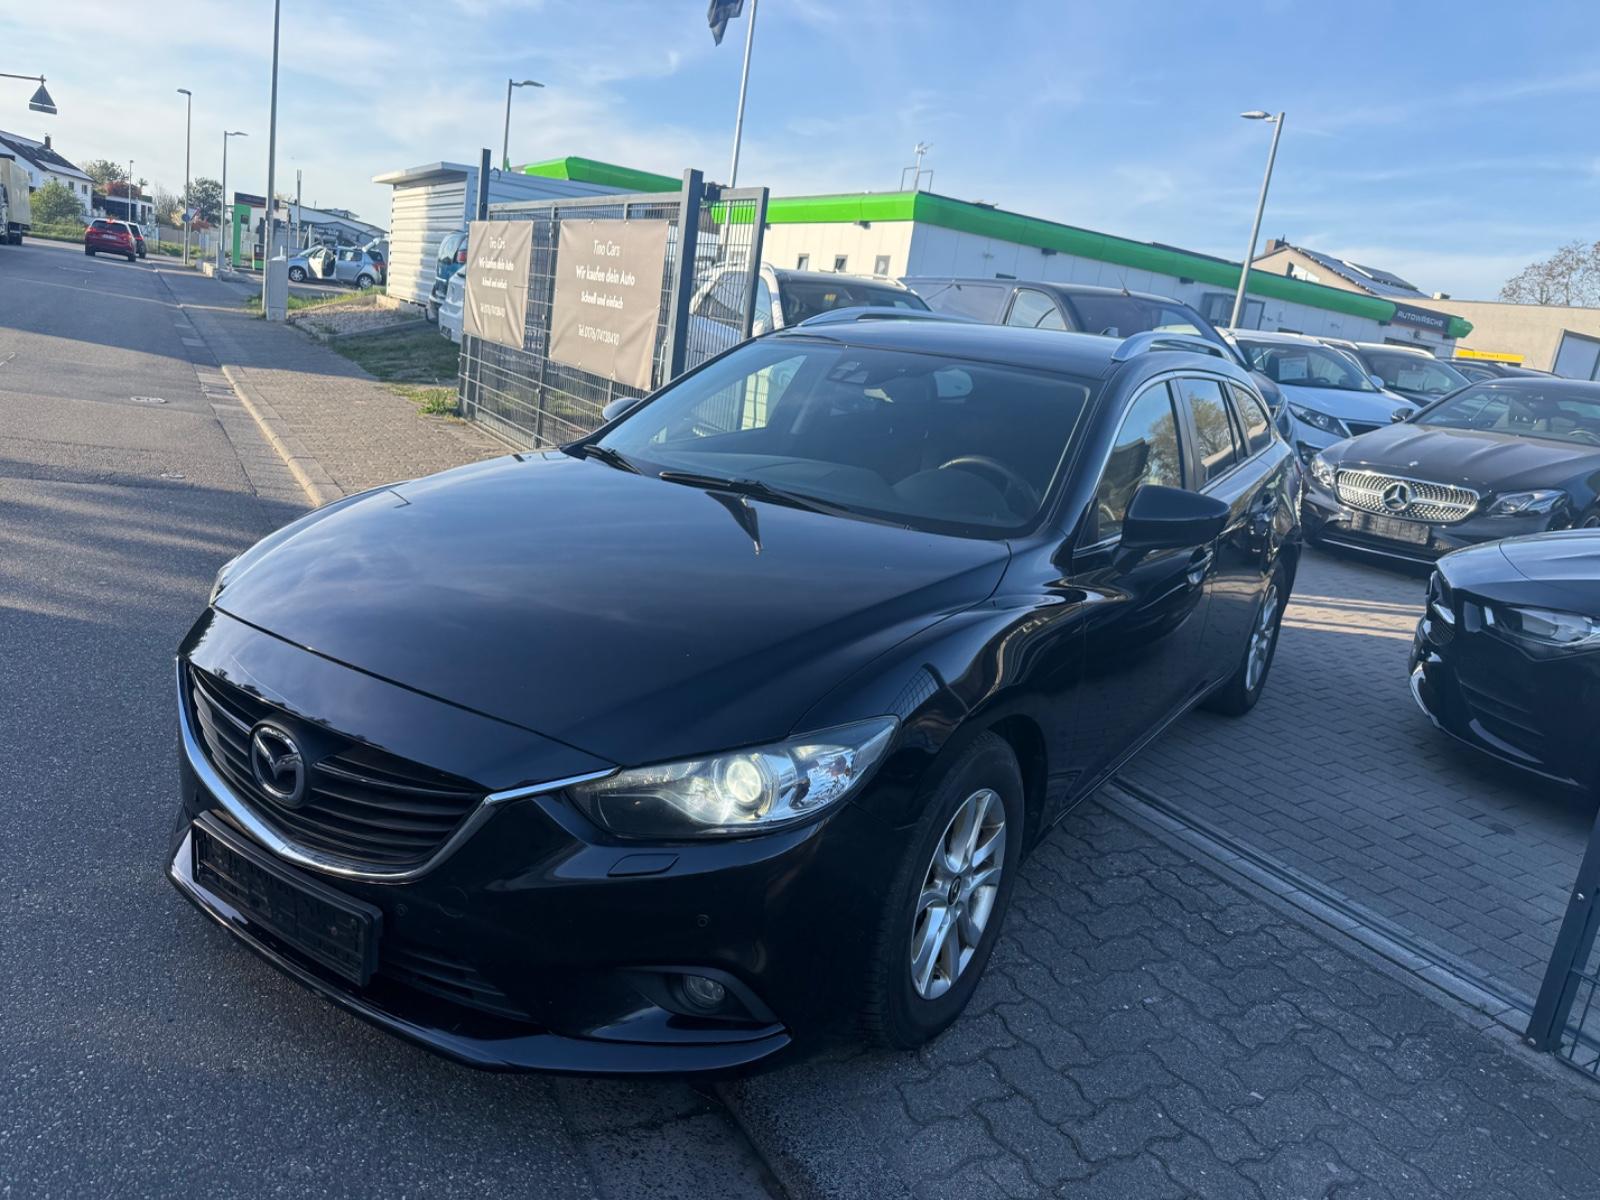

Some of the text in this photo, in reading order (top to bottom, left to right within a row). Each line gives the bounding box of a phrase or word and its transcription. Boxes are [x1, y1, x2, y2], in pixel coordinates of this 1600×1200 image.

[606, 240, 620, 256] Cars
[576, 265, 636, 286] Wir kaufen dein Auto
[597, 293, 606, 307] und
